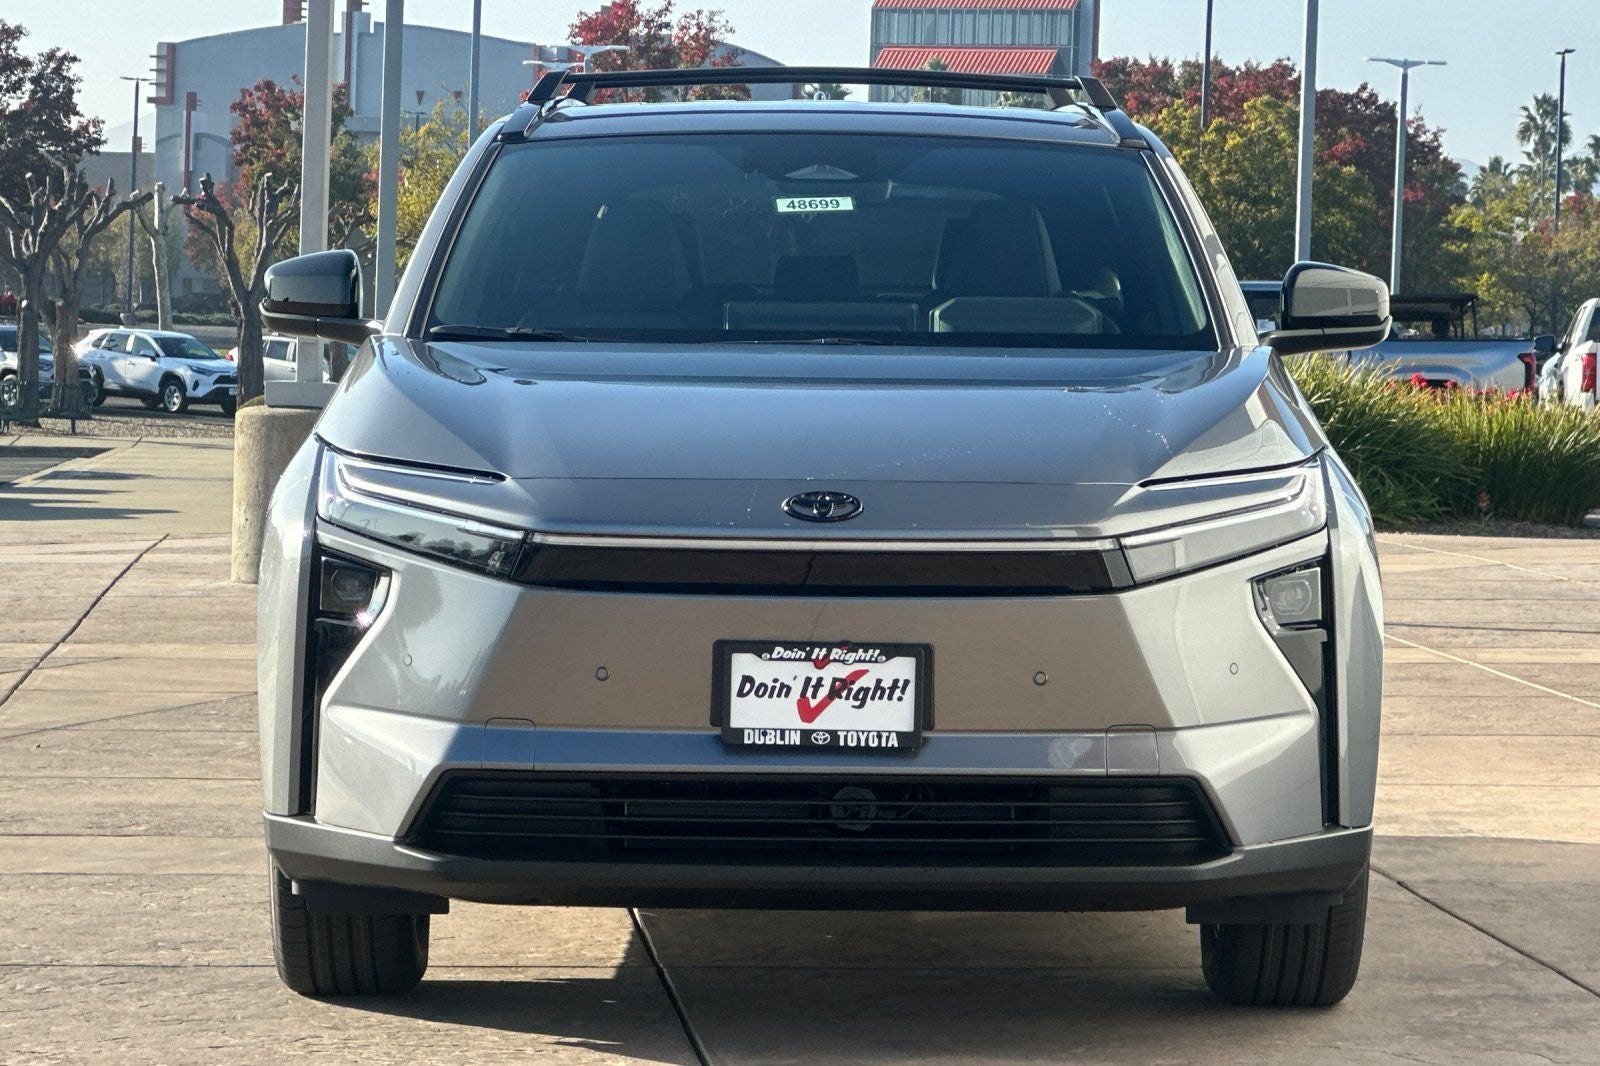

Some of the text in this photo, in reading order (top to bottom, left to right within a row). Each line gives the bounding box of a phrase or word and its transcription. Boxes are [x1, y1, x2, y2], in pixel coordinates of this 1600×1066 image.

[786, 199, 840, 209] 48699
[771, 646, 881, 664] Doin' It Right!
[736, 675, 911, 709] Doin' It Right!
[743, 728, 899, 748] DUBLIN TOYOTA
